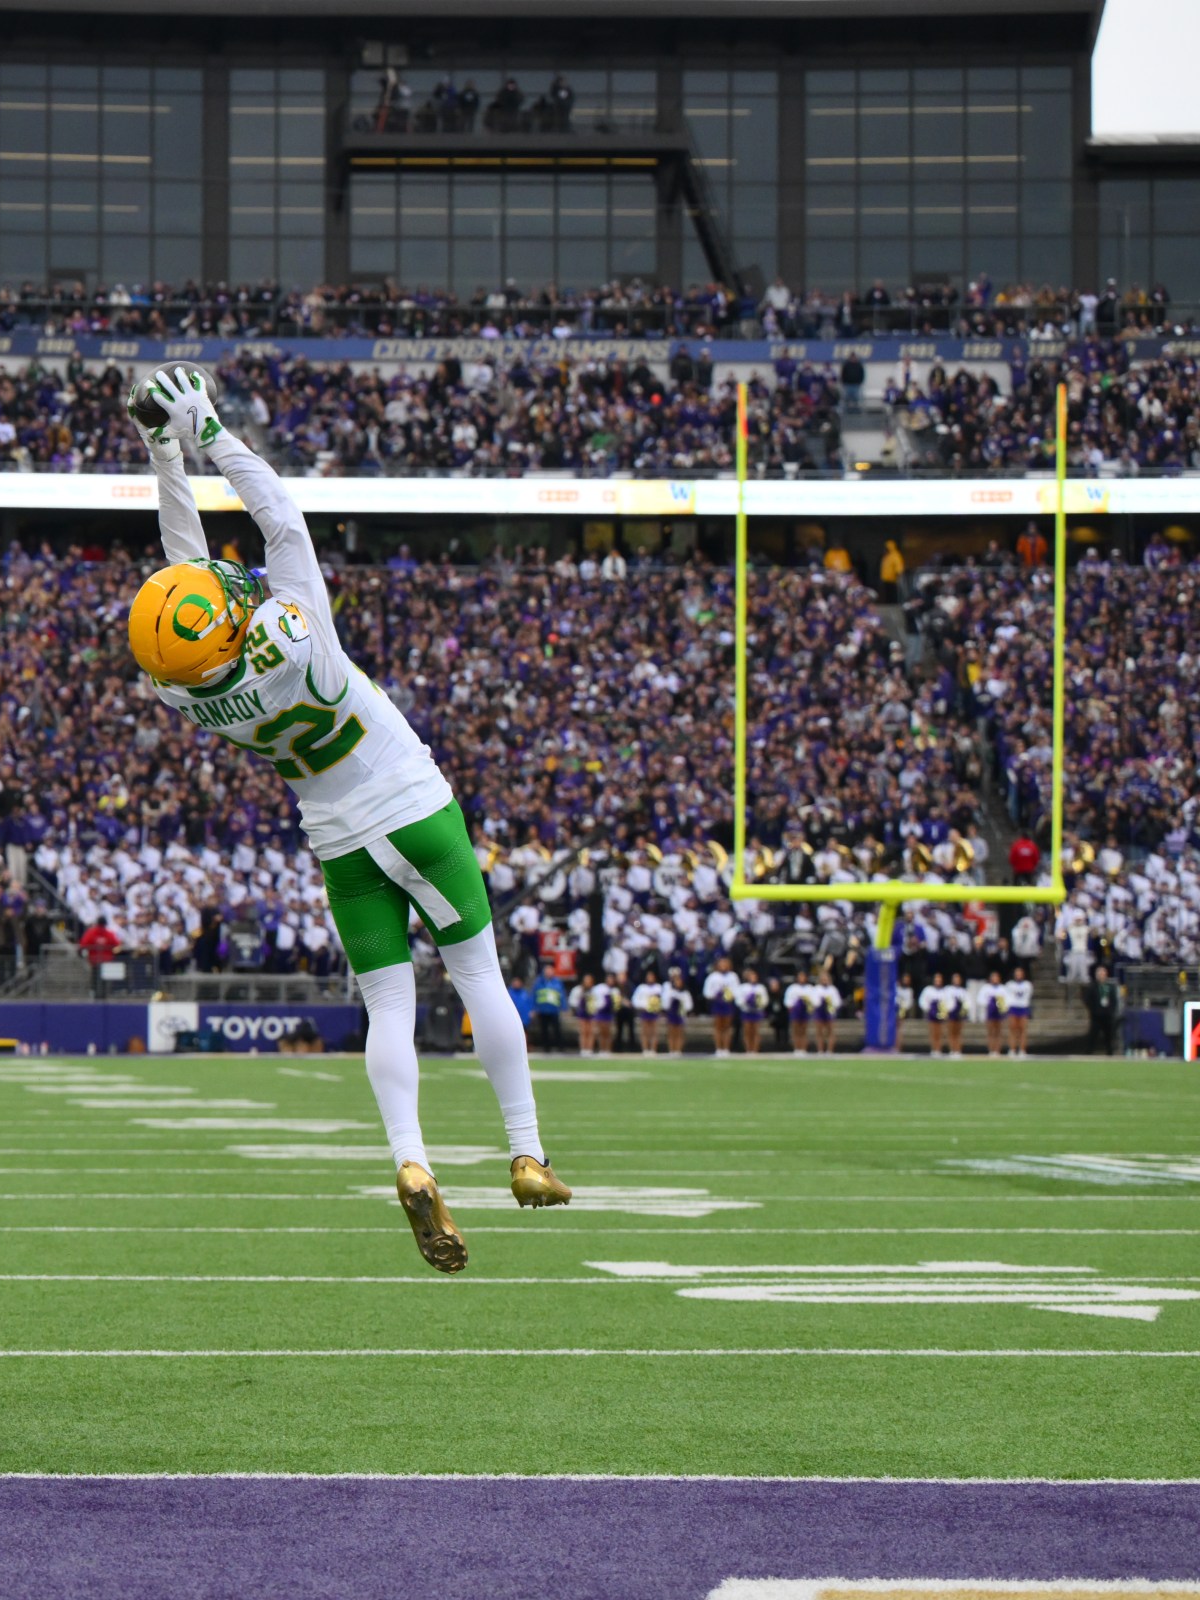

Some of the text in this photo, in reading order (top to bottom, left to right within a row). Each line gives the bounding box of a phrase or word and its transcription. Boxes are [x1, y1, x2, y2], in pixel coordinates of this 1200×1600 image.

[372, 338, 670, 361] CONFERENCE CHAMPIONS
[179, 689, 267, 728] CANADY
[206, 1016, 318, 1041] TOYOT
